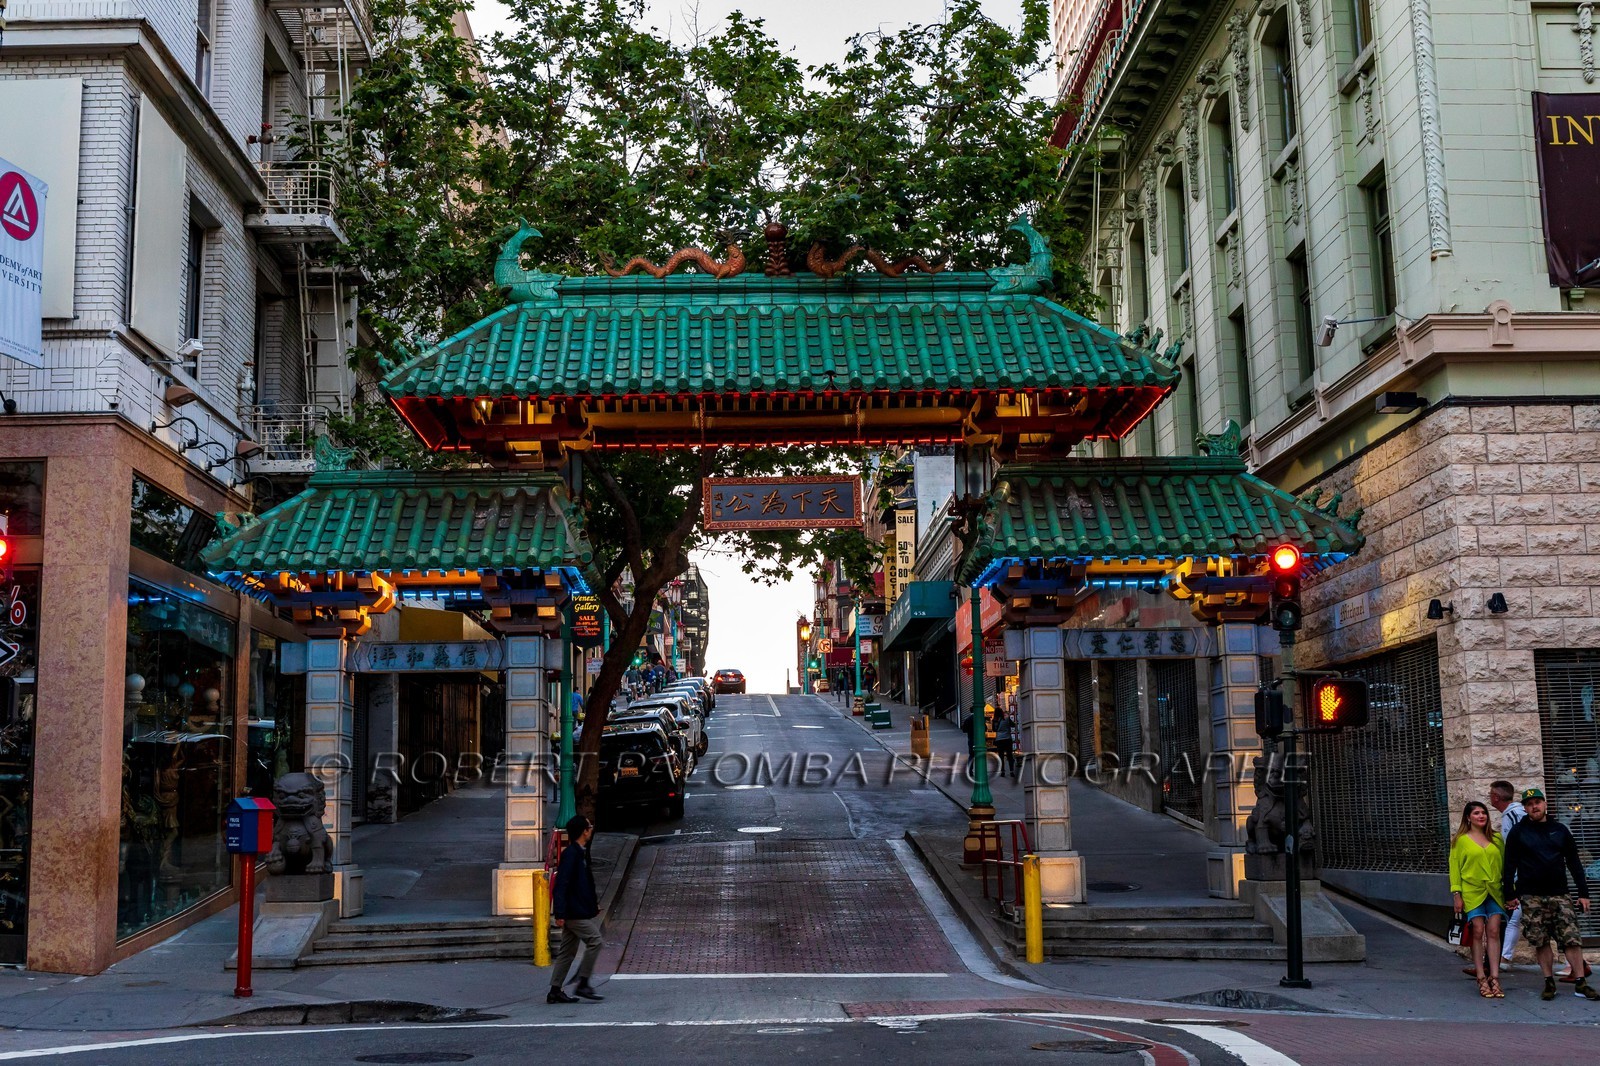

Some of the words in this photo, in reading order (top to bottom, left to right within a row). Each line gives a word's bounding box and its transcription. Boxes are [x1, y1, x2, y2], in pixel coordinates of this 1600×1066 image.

[1546, 115, 1600, 145] IN
[897, 515, 914, 524] SALE
[574, 602, 600, 613] Gallery
[985, 645, 995, 654] NO
